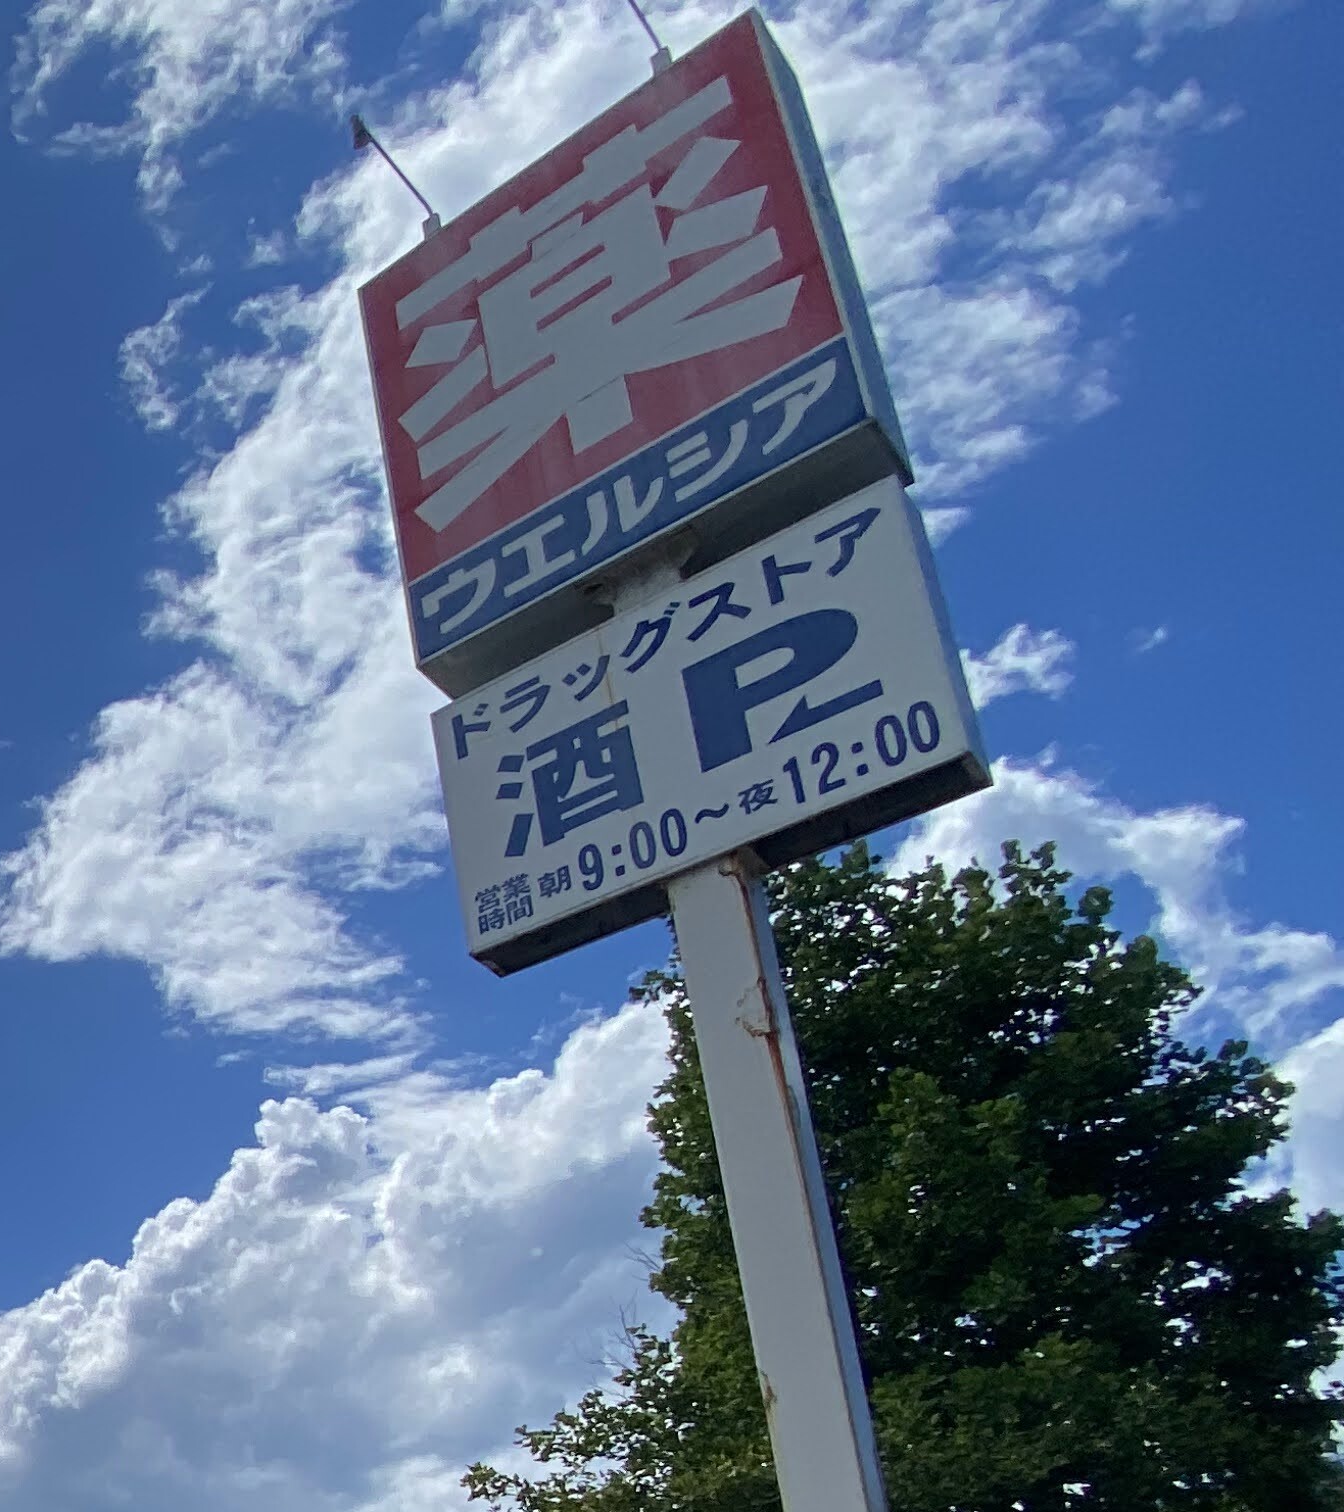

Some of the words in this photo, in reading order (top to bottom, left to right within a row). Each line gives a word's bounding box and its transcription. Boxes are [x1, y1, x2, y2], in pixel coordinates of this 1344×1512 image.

[396, 76, 804, 532] 薬
[421, 355, 837, 635] ウエルシア
[451, 507, 882, 760] ドラッグストア
[684, 609, 859, 772] P
[496, 700, 644, 857] 酒
[475, 872, 530, 912] 営業
[478, 895, 534, 935] 時間
